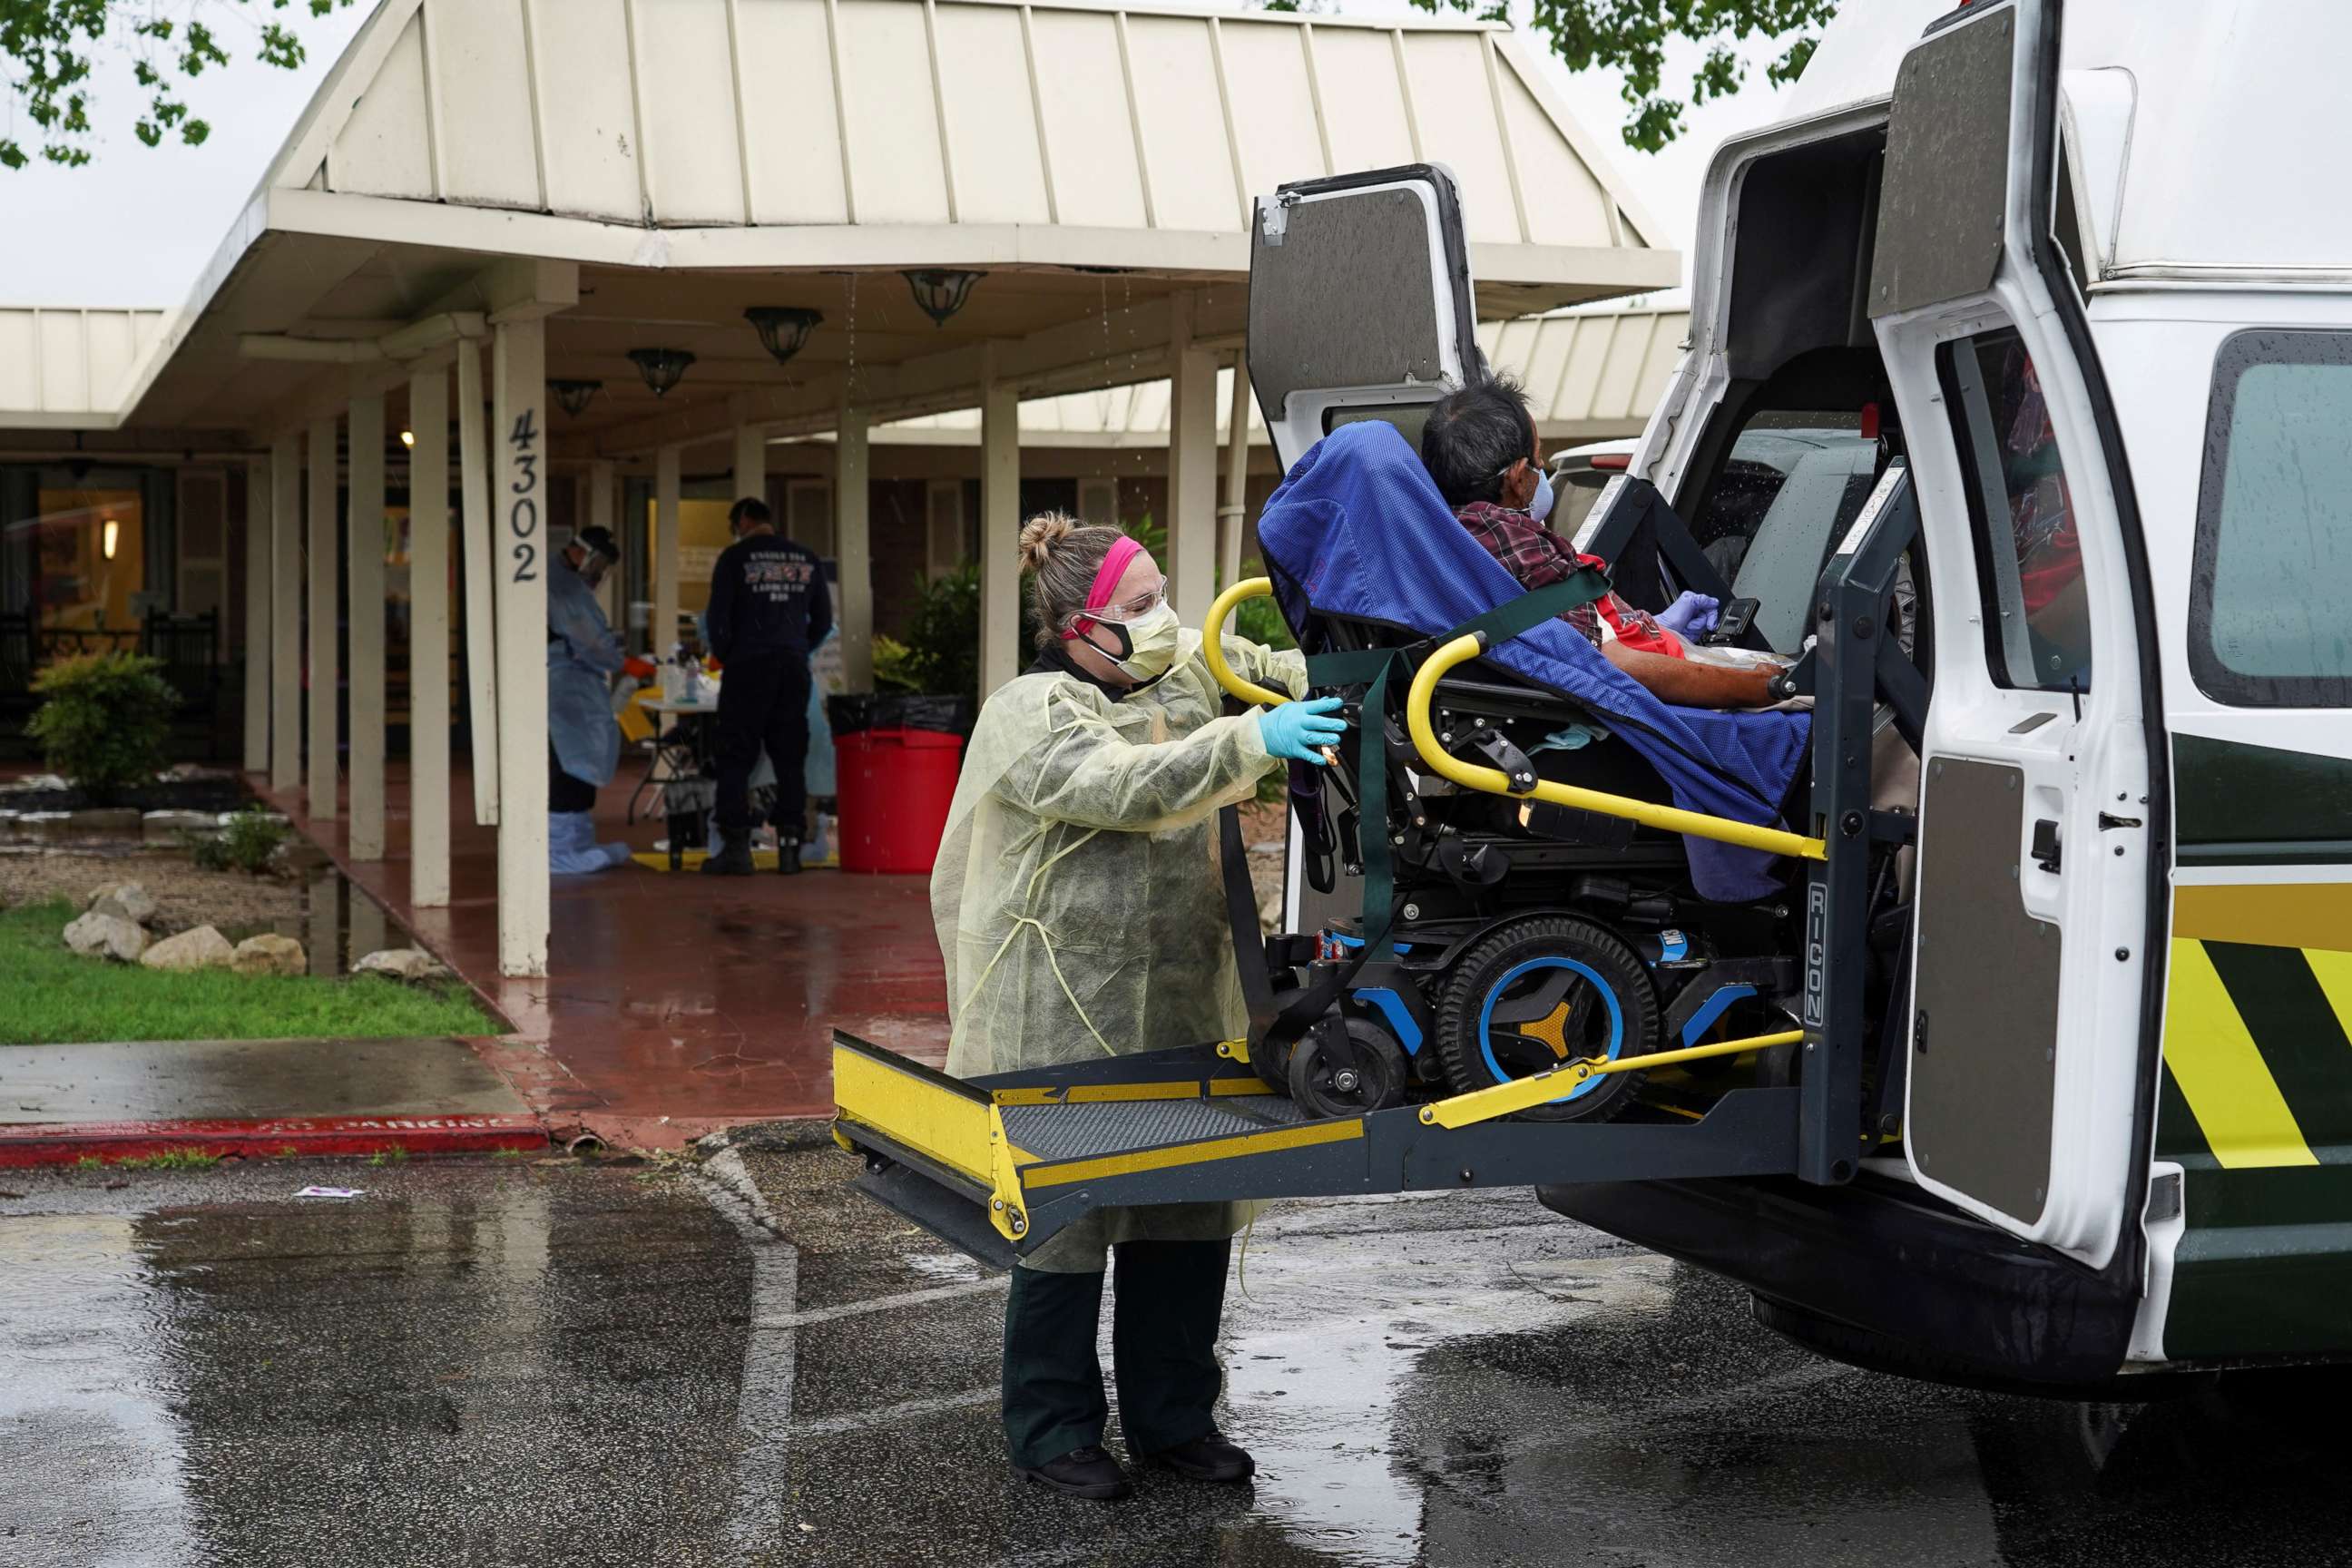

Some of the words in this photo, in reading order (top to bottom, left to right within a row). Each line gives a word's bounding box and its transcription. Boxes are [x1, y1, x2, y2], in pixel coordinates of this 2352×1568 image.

[509, 408, 539, 583] 4302
[1661, 929, 1684, 946] M3
[1807, 890, 1824, 1018] RICON
